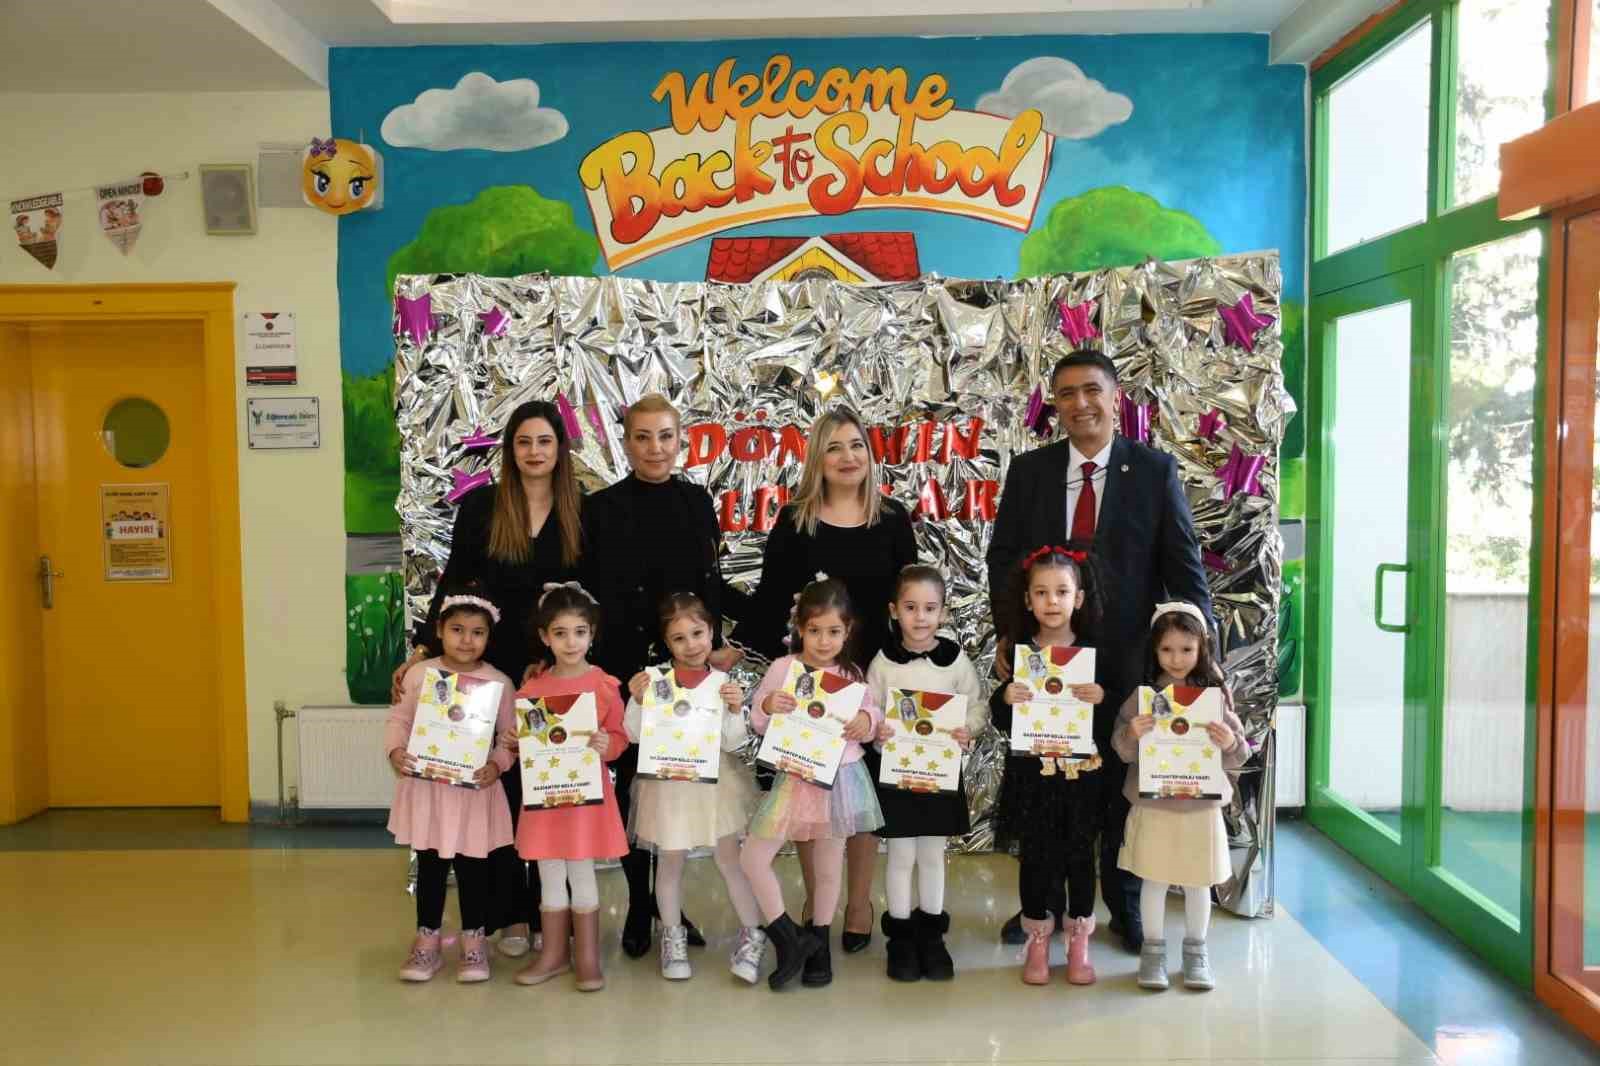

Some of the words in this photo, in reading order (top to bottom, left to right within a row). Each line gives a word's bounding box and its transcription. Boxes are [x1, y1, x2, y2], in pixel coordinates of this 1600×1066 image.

[650, 54, 955, 136] Welcome
[578, 114, 775, 244] Back
[772, 125, 815, 191] to
[808, 108, 1044, 216] School
